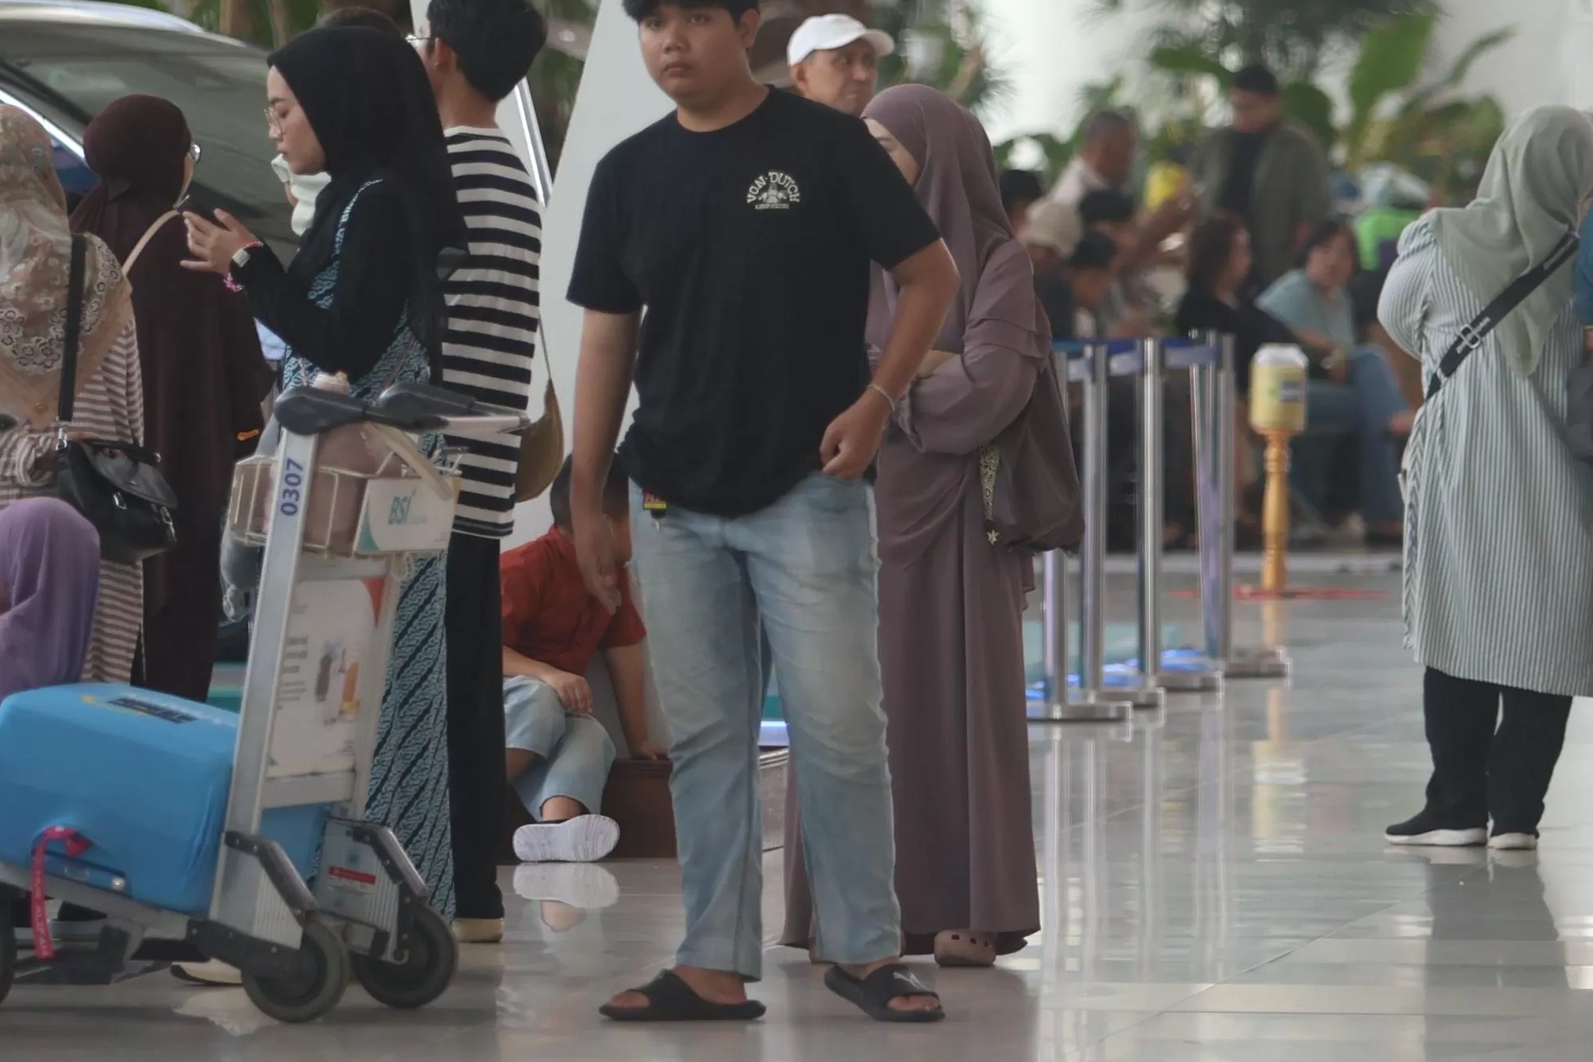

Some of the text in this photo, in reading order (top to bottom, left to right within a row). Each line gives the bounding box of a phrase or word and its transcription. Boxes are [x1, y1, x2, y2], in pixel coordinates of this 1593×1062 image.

[747, 171, 800, 204] VON DUTCH
[280, 457, 304, 516] 0307
[388, 495, 413, 525] BSI
